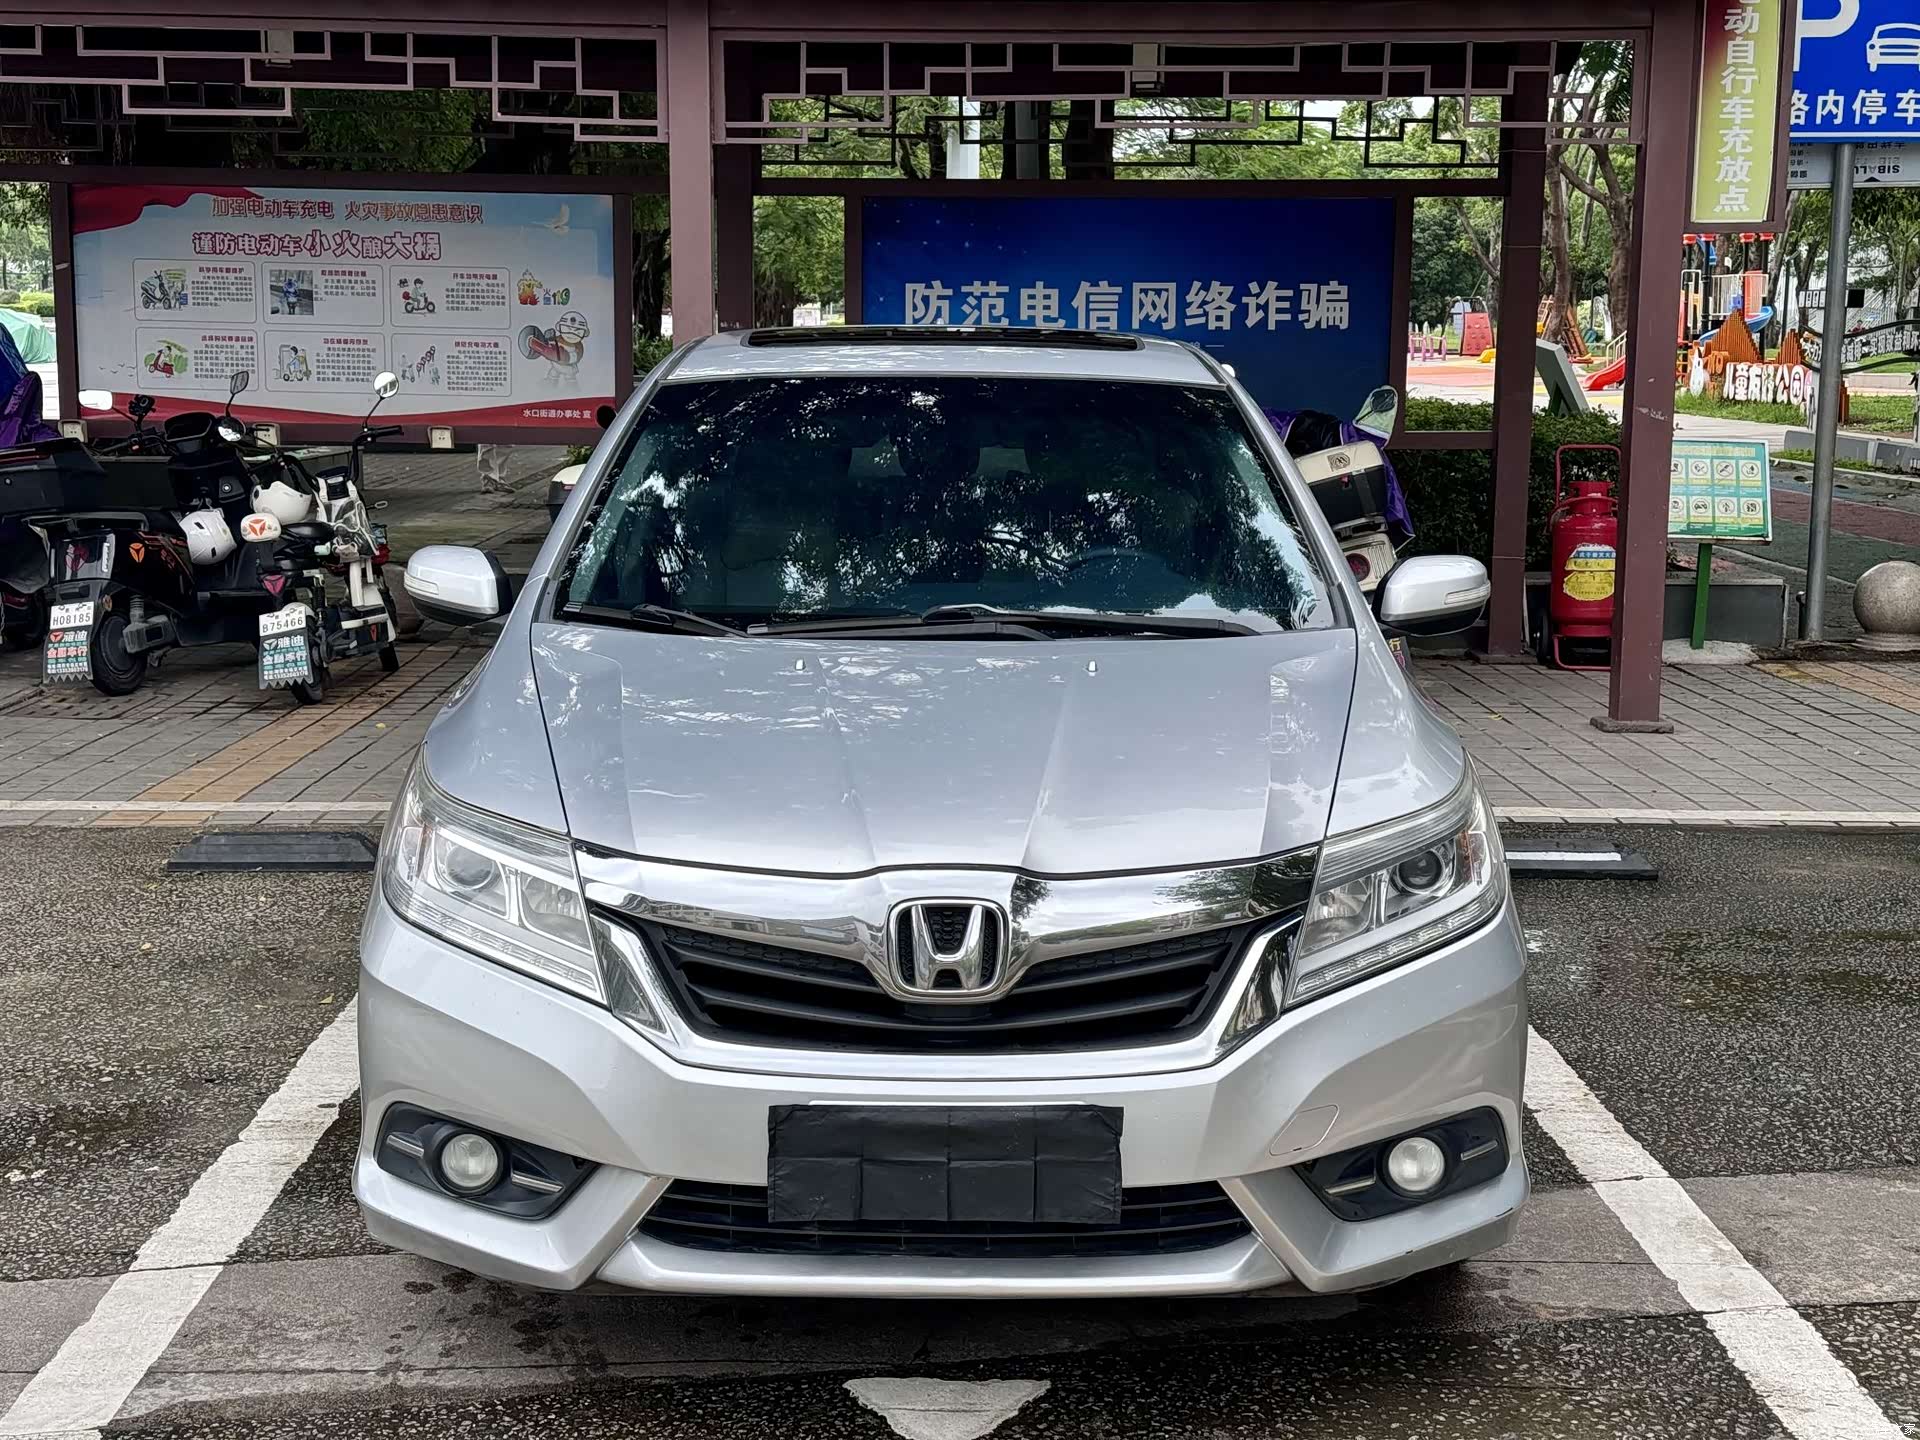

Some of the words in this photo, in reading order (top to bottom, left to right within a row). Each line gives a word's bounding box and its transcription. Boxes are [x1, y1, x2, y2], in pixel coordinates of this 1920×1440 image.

[1793, 0, 1860, 73] P
[1713, 0, 1760, 213] 动自行车充放点
[212, 197, 334, 218] 加强电动车充电
[344, 202, 483, 223] 火灾事故隐患意识
[192, 229, 441, 260] 谨防电动车小火酿大祸
[905, 280, 1349, 331] 防范电信网络诈骗
[523, 409, 581, 419] 水口街道办事处
[53, 612, 91, 626] H08185
[262, 616, 304, 633] B75466
[277, 635, 304, 649] 雅迪
[911, 904, 984, 991] H
